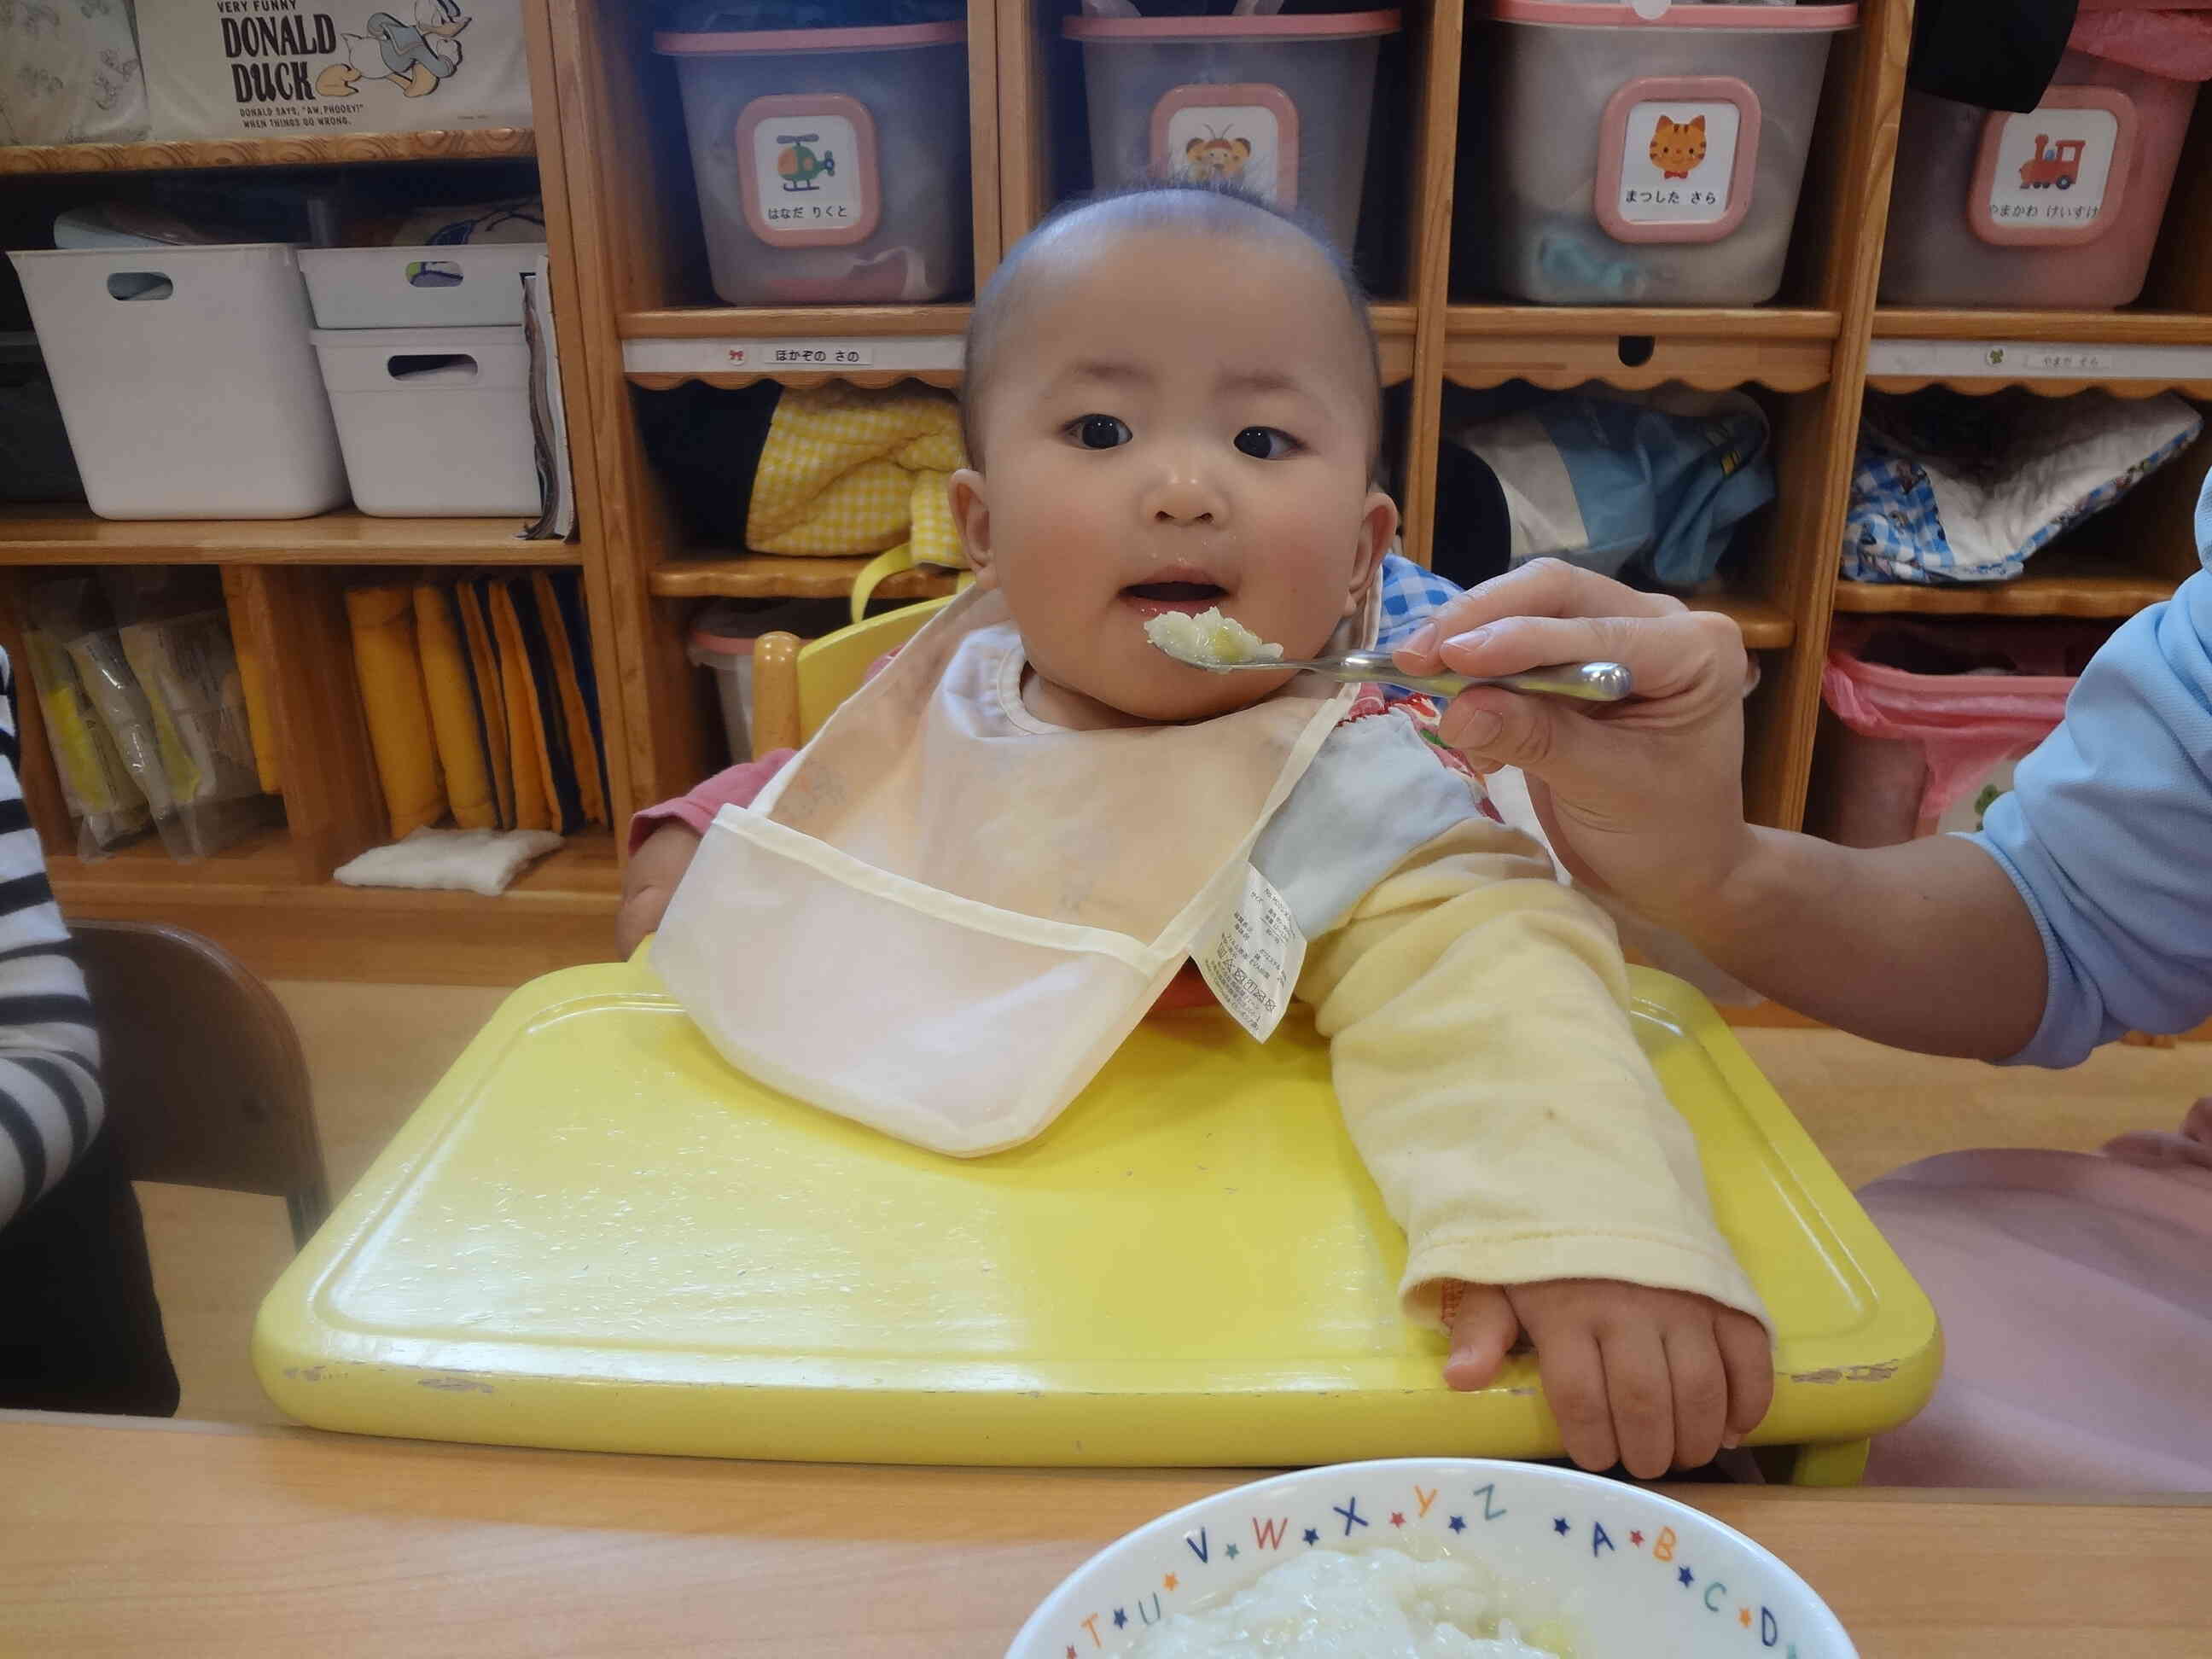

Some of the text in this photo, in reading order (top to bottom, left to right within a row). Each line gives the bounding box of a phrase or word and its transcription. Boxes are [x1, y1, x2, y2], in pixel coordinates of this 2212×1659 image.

[217, 0, 297, 13] VERY FUNNY
[221, 14, 337, 58] DONALD
[231, 61, 316, 102] DUCK
[240, 107, 273, 118] DONALD
[242, 119, 267, 129] WHEN
[270, 118, 300, 127] THINGS
[1626, 189, 1679, 204] まつした
[768, 206, 847, 219] はなだ りくと
[1081, 1483, 1778, 1648] T U V W X Y Z A B C D
